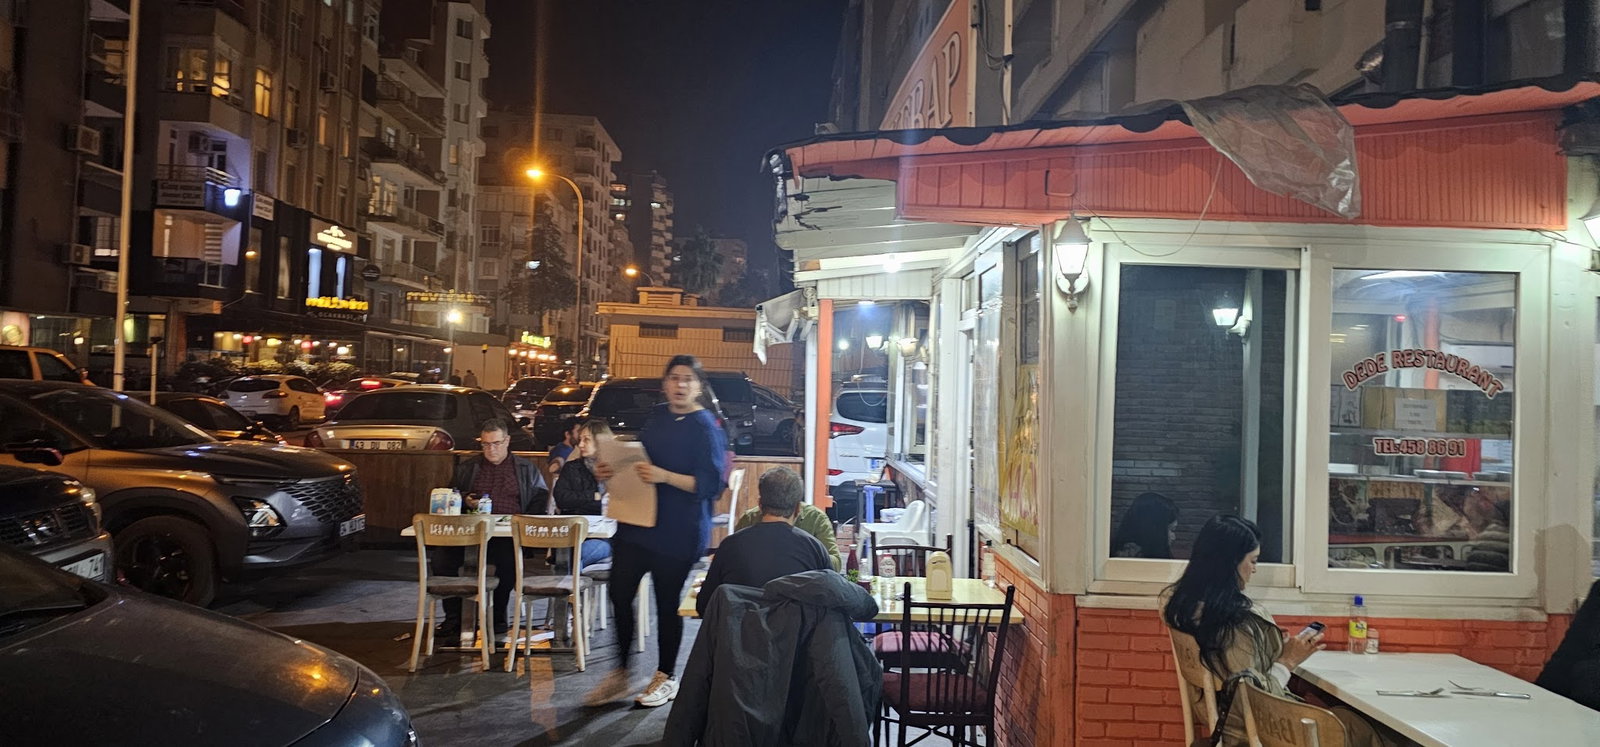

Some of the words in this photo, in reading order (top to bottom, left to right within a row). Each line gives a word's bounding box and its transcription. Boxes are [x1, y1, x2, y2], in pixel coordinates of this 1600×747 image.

[1342, 352, 1387, 391] DEDE
[1391, 349, 1505, 400] RESTAURANT
[1427, 438, 1446, 456] 86
[1448, 438, 1466, 456] 91
